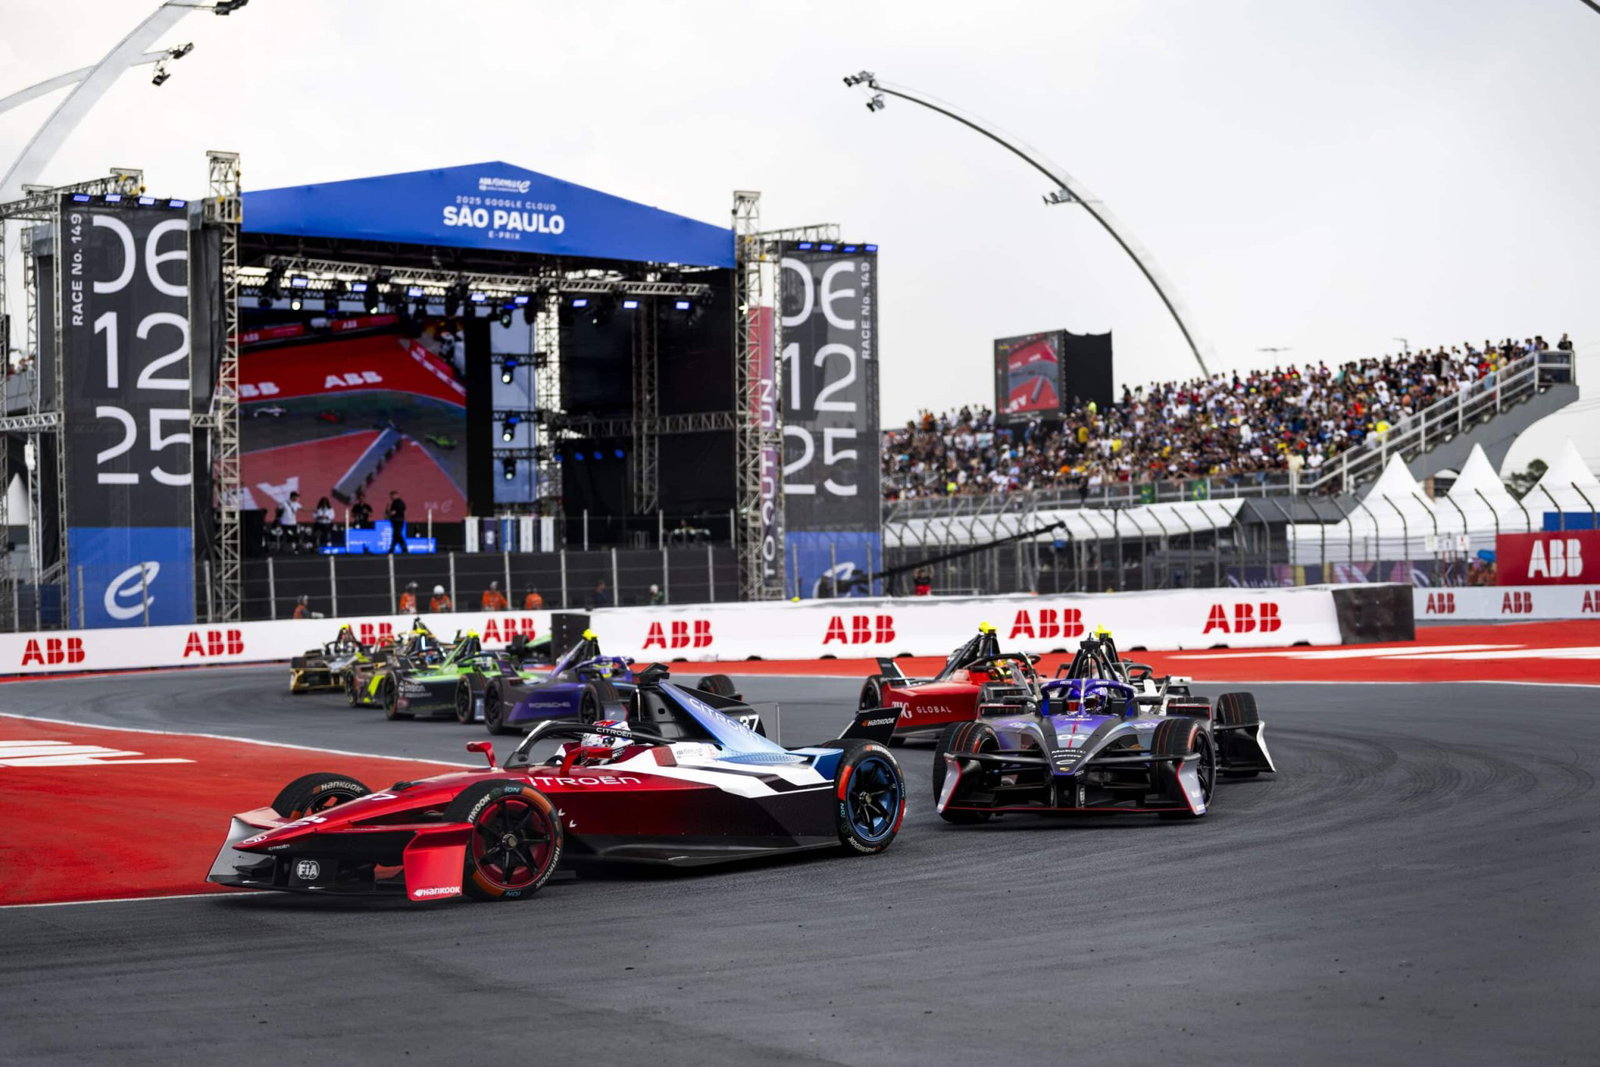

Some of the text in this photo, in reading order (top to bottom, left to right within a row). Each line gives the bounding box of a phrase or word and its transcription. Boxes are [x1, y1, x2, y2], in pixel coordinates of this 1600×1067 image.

[456, 195, 557, 211] 2025 GOOGLE CLOUD
[443, 205, 565, 235] SÃO PAULO
[71, 213, 83, 325] RACE No. 149
[861, 262, 870, 288] 149
[94, 311, 189, 390] 12
[862, 320, 871, 359] RACE
[238, 382, 280, 398] BB
[324, 371, 383, 388] ABB
[782, 342, 857, 412] 12
[96, 406, 191, 486] 25
[782, 425, 857, 496] 25
[1528, 538, 1583, 578] ABB
[1425, 592, 1456, 614] ABB
[1502, 591, 1533, 614] ABB
[482, 618, 536, 643] ABB
[822, 615, 896, 644] ABB
[1008, 608, 1084, 639] ABB
[1202, 602, 1281, 634] ABB
[183, 630, 244, 657] ABB
[348, 622, 395, 648] BB
[642, 620, 713, 649] ABB
[21, 638, 85, 666] ABB
[739, 714, 759, 732] 37
[916, 705, 952, 714] GLOBAL
[297, 863, 318, 876] FIA
